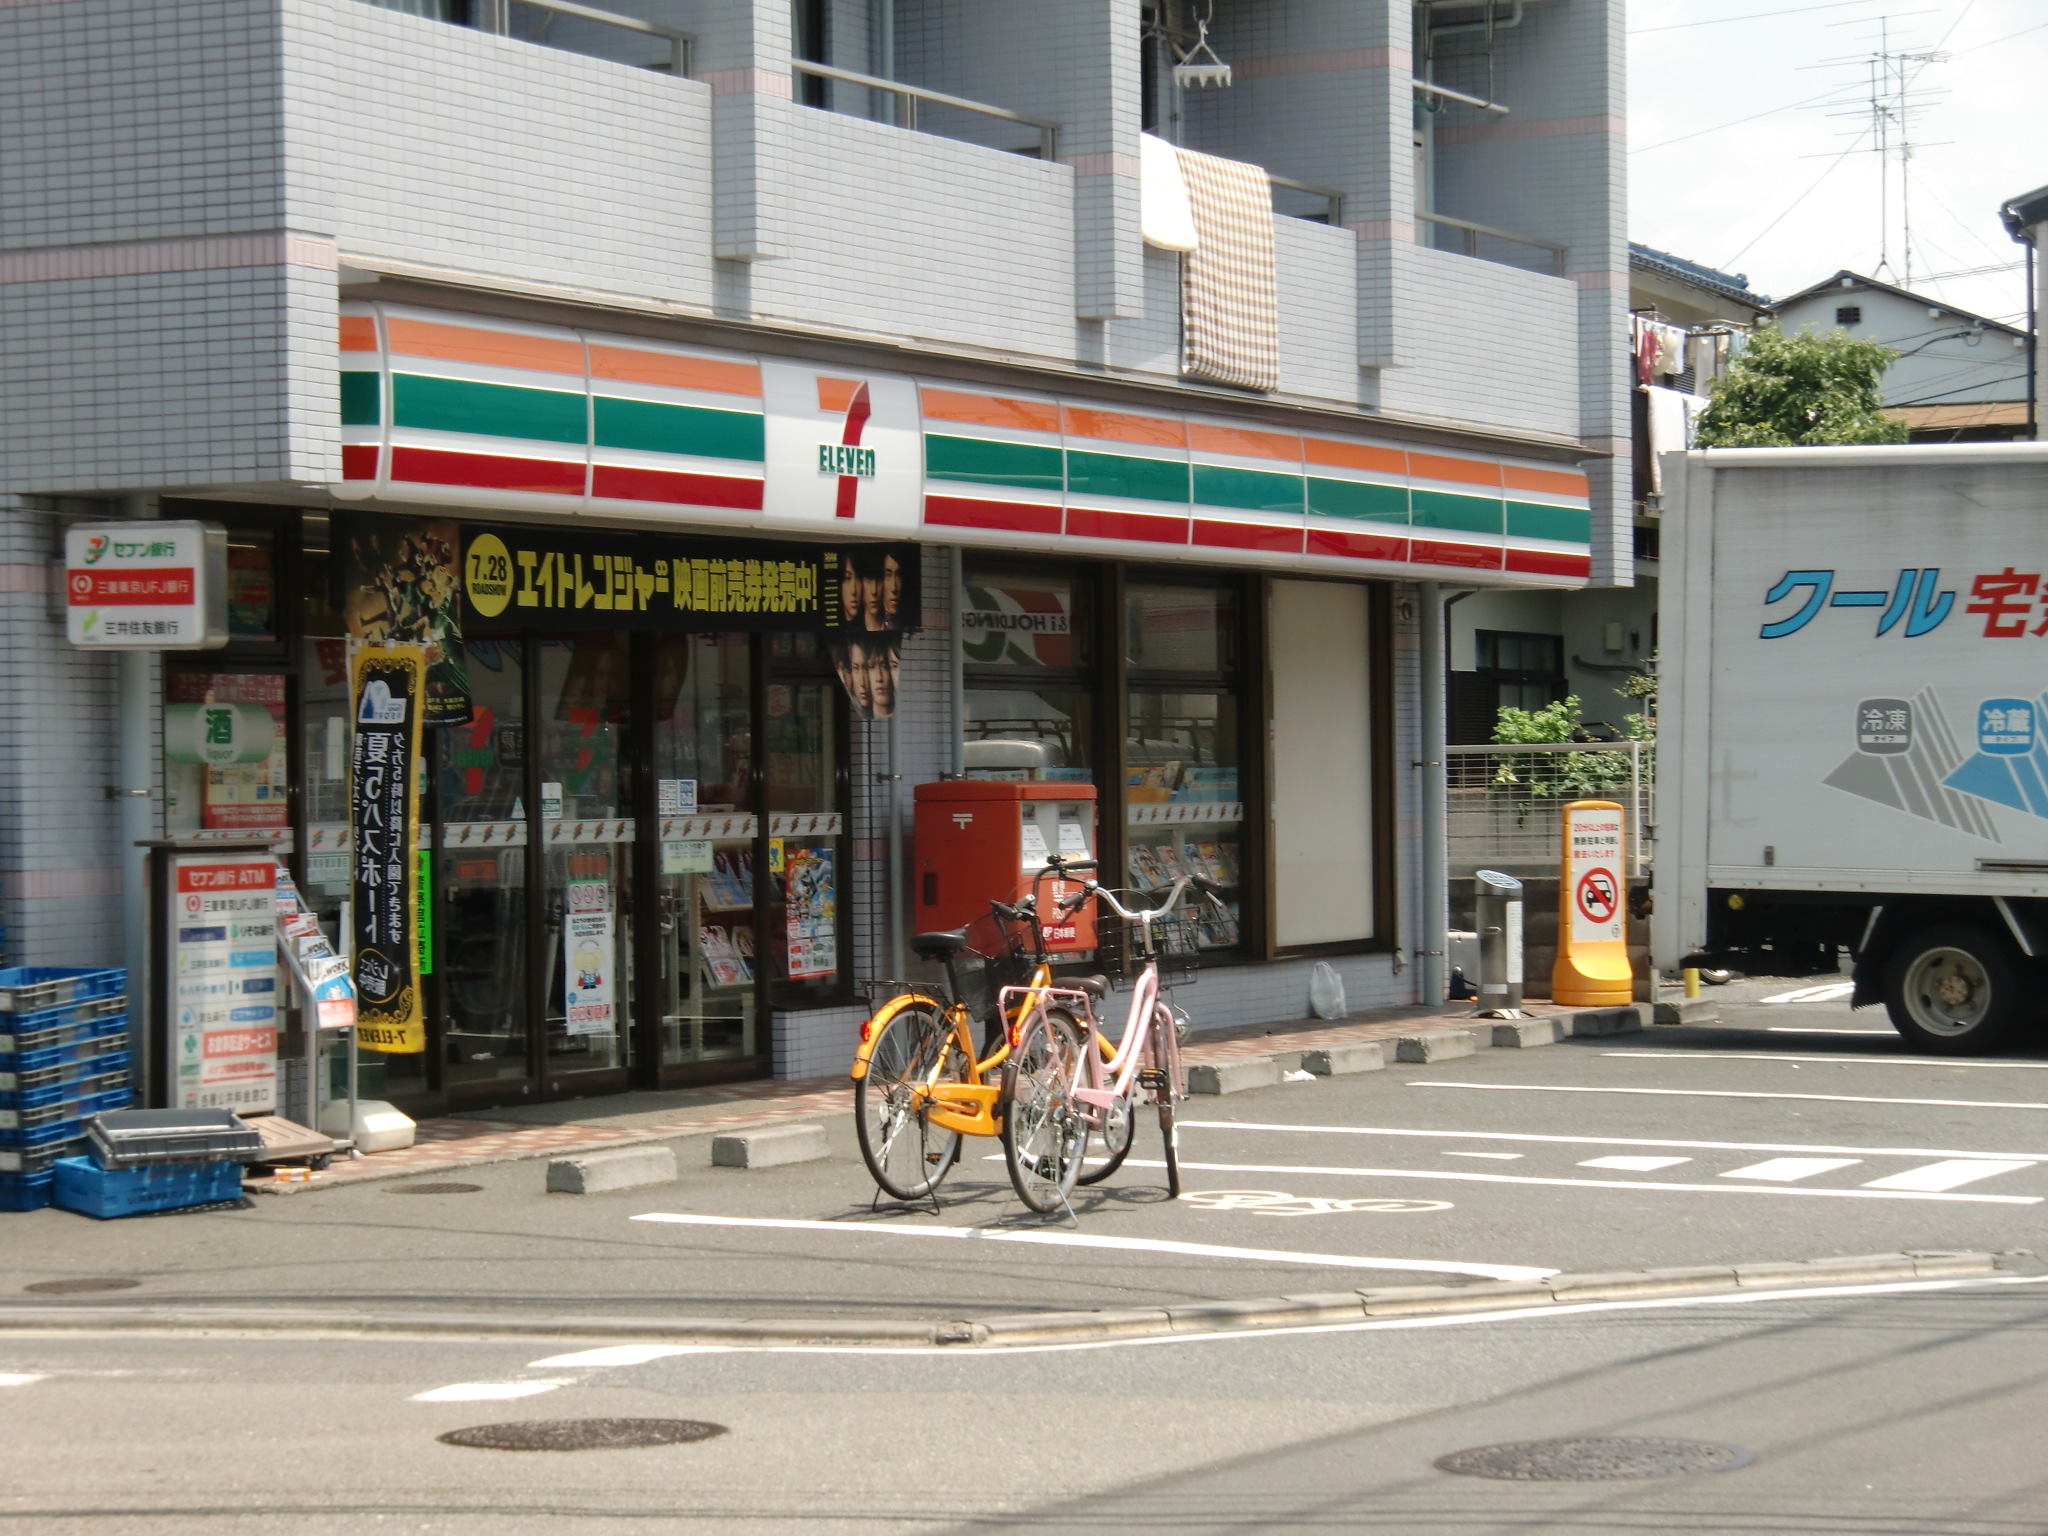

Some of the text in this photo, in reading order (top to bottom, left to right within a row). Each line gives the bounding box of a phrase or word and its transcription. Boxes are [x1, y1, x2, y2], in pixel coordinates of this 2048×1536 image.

[113, 541, 176, 558] セブン銀行
[472, 554, 507, 582] 7.28
[97, 580, 189, 594] 三菱東京UFJ銀行
[472, 583, 507, 596] ROADSHOW
[105, 621, 179, 635] 三井住友銀行
[206, 708, 232, 744] 酒
[1861, 708, 1907, 731] 冷凍
[1982, 708, 2030, 732] 冷蔵
[189, 869, 266, 887] セブン銀行 ATM
